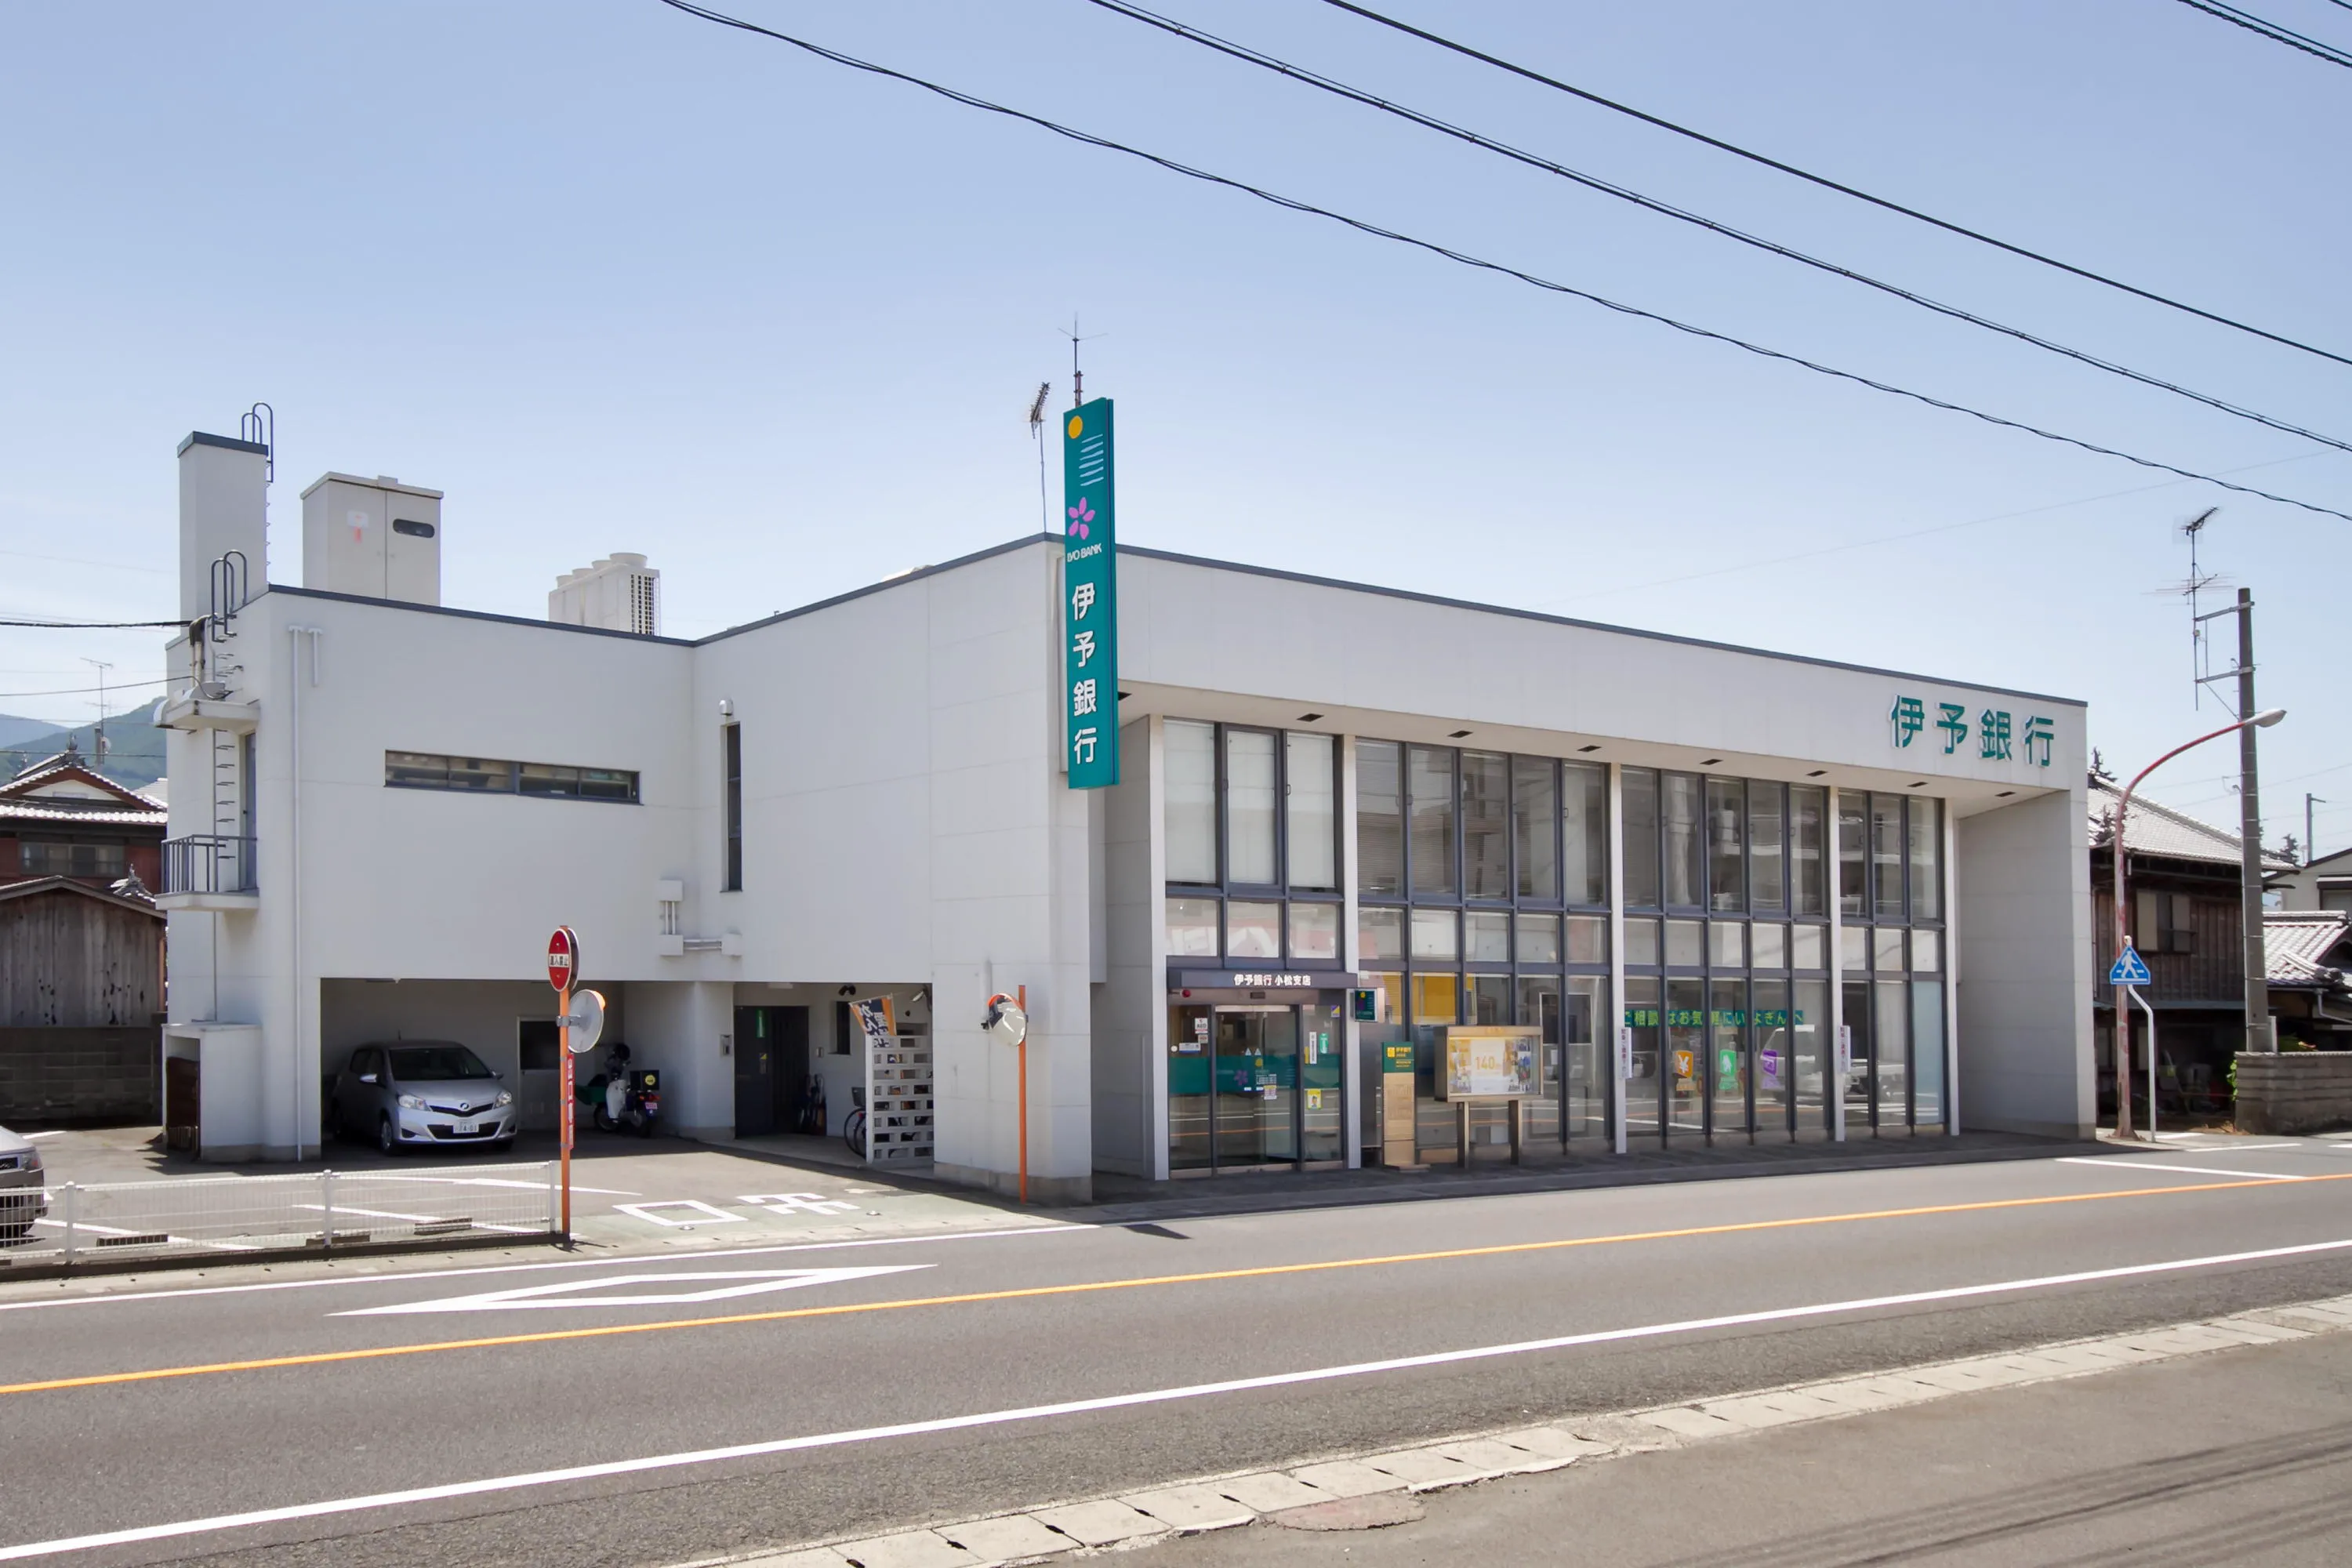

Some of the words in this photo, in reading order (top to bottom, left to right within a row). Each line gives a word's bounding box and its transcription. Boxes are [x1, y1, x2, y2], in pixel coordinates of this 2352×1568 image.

[1081, 543, 1102, 558] BANK
[1072, 582, 1097, 765] 伊予銀行
[1888, 693, 2055, 768] 伊予銀行
[1234, 974, 1272, 986] 伊予銀行
[1275, 975, 1311, 986] 小松支店
